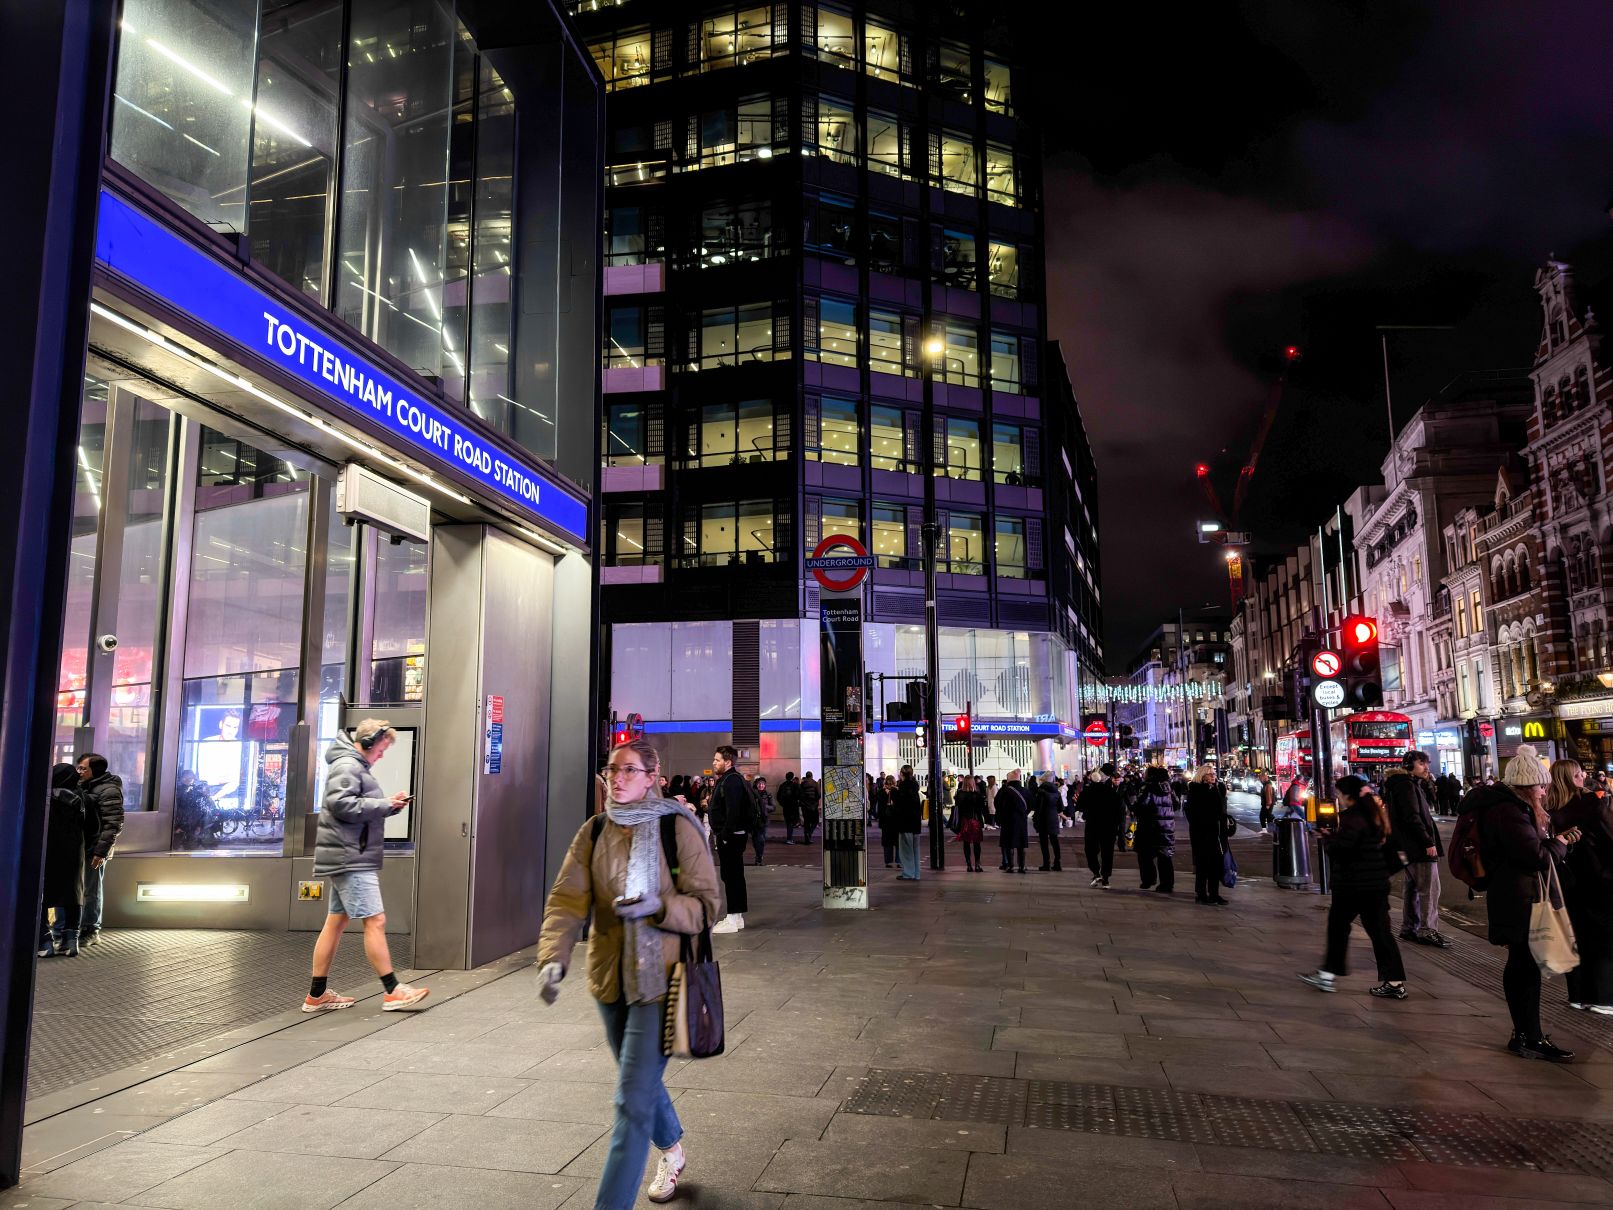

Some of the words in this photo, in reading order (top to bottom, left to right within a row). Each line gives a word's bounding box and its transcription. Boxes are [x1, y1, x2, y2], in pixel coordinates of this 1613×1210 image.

[263, 312, 391, 416] TOTTENHAM
[396, 398, 451, 451] COURT
[453, 433, 492, 475] ROAD
[494, 459, 541, 505] STATION
[807, 559, 872, 567] UNDERGROUND
[971, 724, 990, 732] COURT
[990, 724, 1006, 732] ROAD
[1394, 747, 1406, 756] 73
